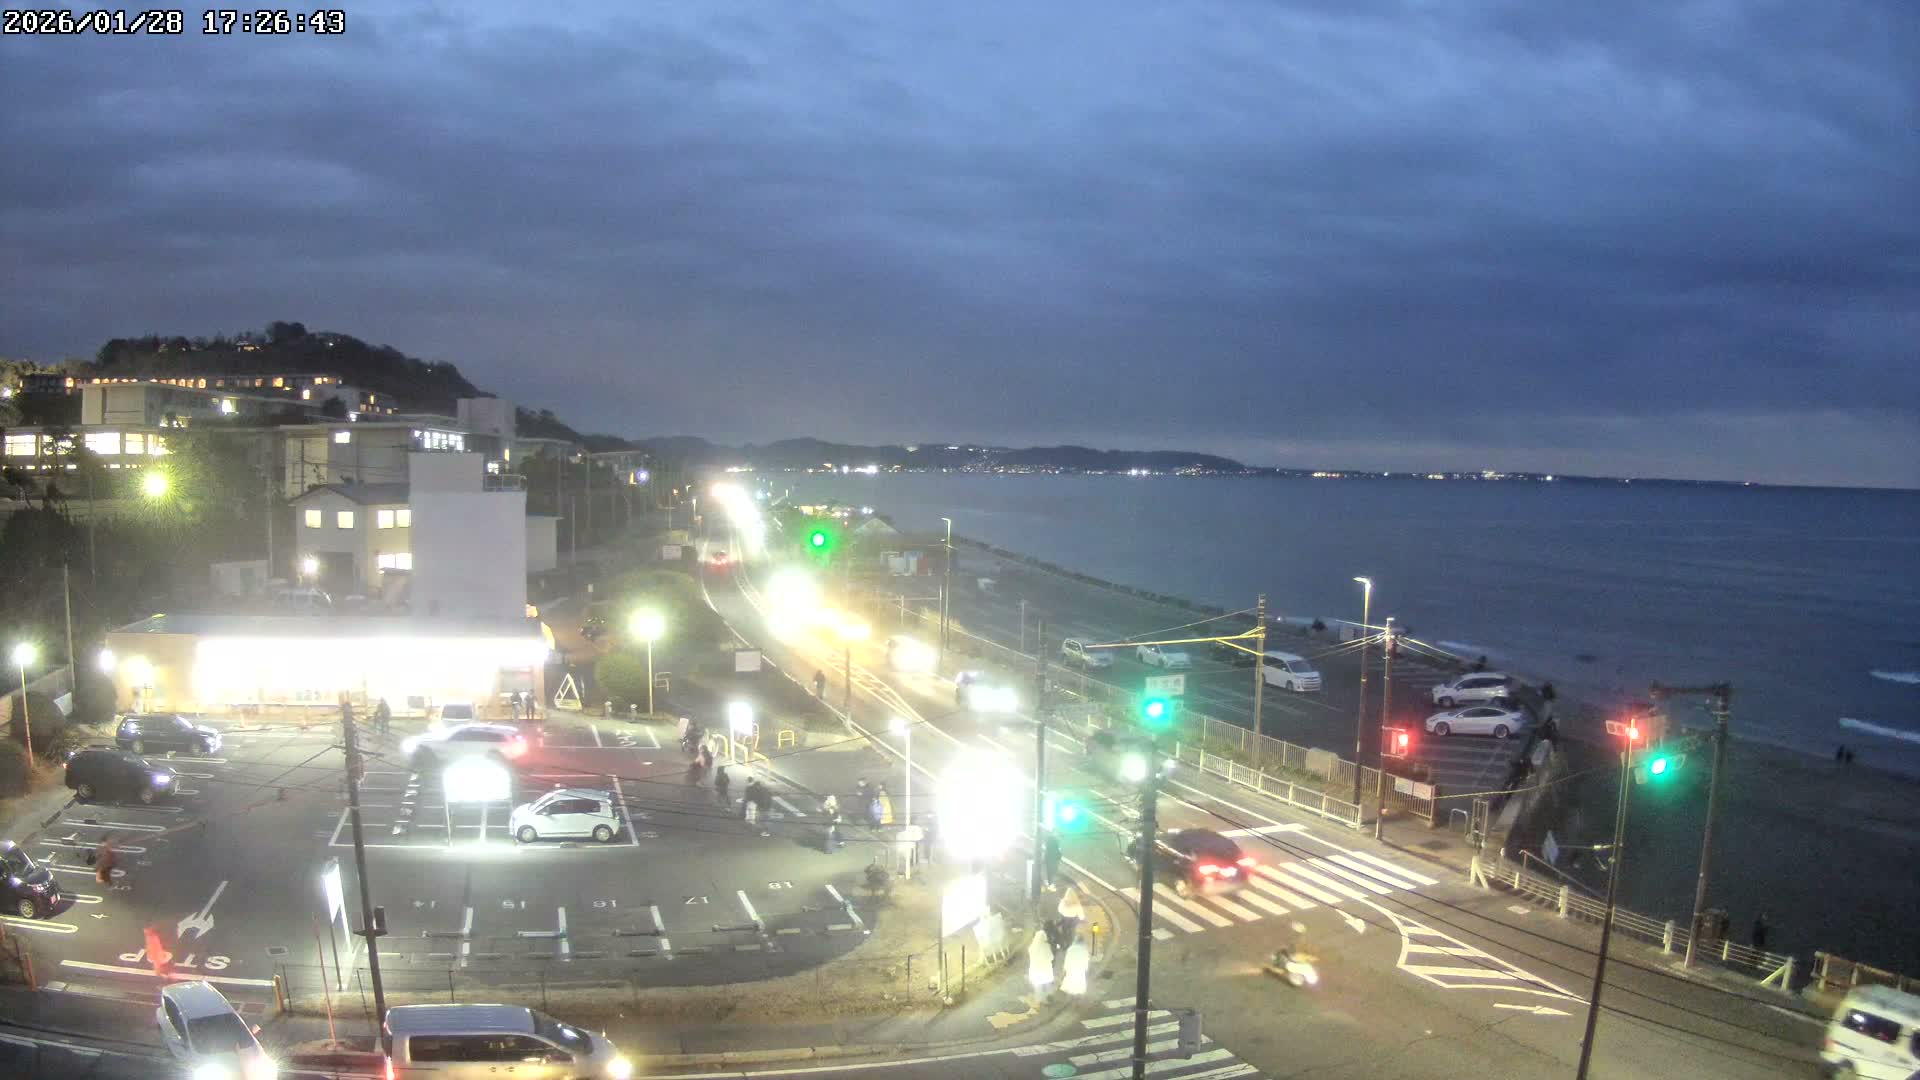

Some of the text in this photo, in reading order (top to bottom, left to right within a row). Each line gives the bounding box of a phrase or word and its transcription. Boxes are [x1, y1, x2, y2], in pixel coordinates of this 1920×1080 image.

[767, 881, 793, 890] 18
[502, 899, 527, 909] 15
[592, 899, 617, 908] 16
[685, 896, 709, 905] 17
